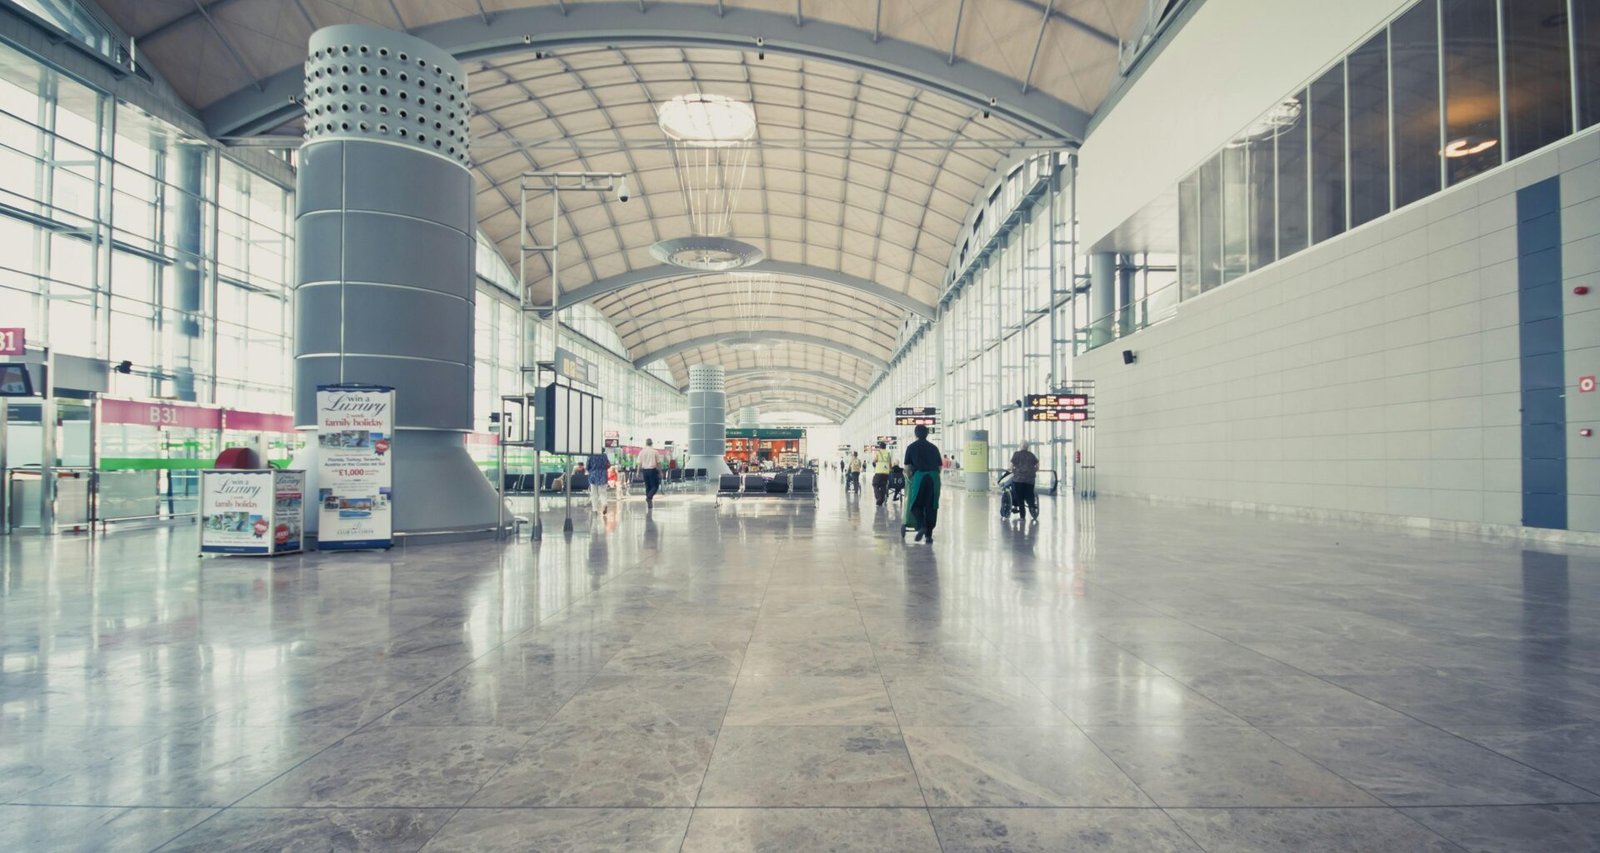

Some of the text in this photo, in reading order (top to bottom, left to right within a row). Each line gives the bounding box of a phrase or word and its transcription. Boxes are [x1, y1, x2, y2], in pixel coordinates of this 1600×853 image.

[321, 394, 386, 417] Luxury
[150, 406, 178, 424] B31
[325, 418, 383, 428] family holiday
[338, 468, 365, 477] £1,000
[214, 479, 262, 498] Luxury
